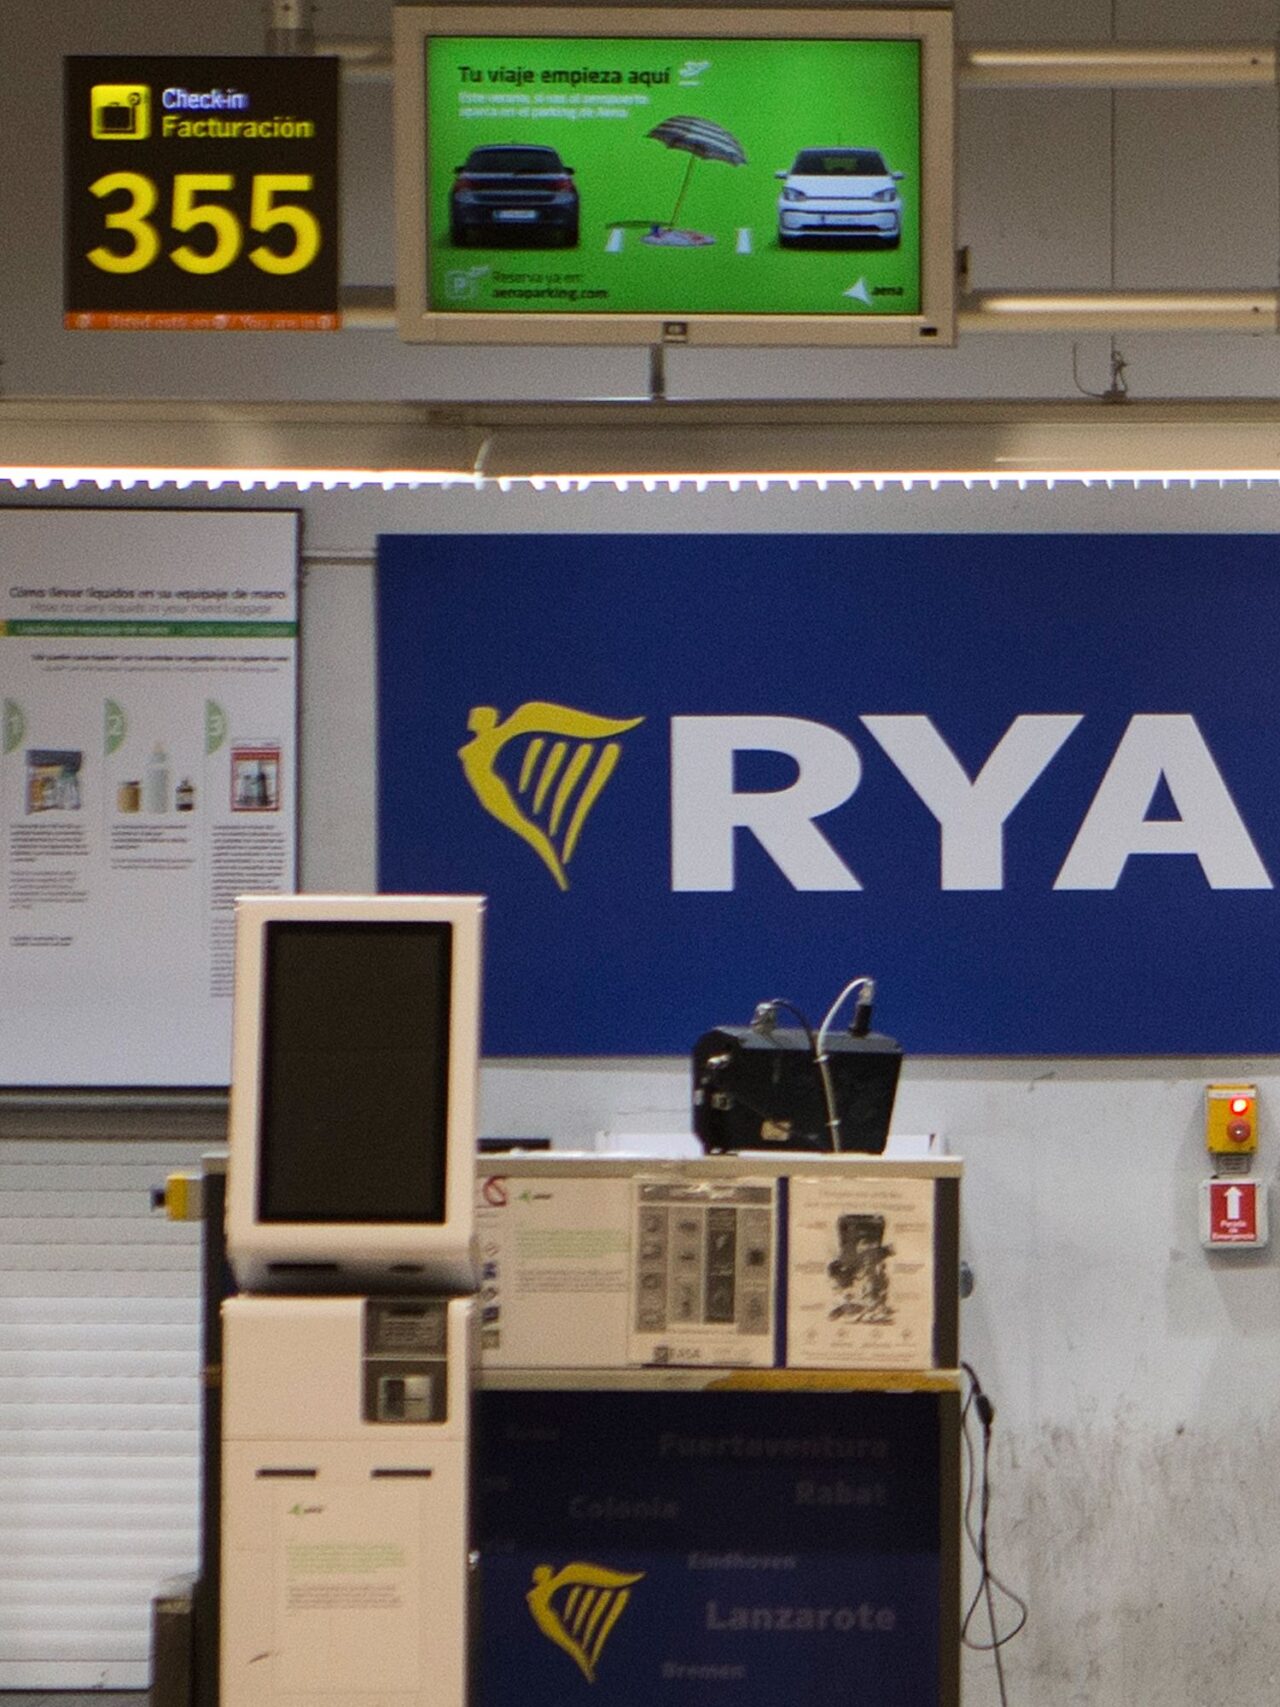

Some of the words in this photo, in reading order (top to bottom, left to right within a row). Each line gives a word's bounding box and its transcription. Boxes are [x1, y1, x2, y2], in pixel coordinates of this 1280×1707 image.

[458, 66, 483, 83] Tu
[488, 66, 535, 87] viaje
[541, 66, 623, 87] empieza
[628, 66, 671, 87] aquí
[161, 87, 249, 111] Check-in
[161, 115, 314, 139] Facturación
[86, 171, 321, 275] 355
[660, 1431, 889, 1458] Fuerteventura
[795, 1481, 888, 1506] Rabat
[686, 1551, 797, 1570] Eindhoven
[705, 1599, 899, 1631] Lanzarote
[660, 1660, 748, 1679] Bremen
